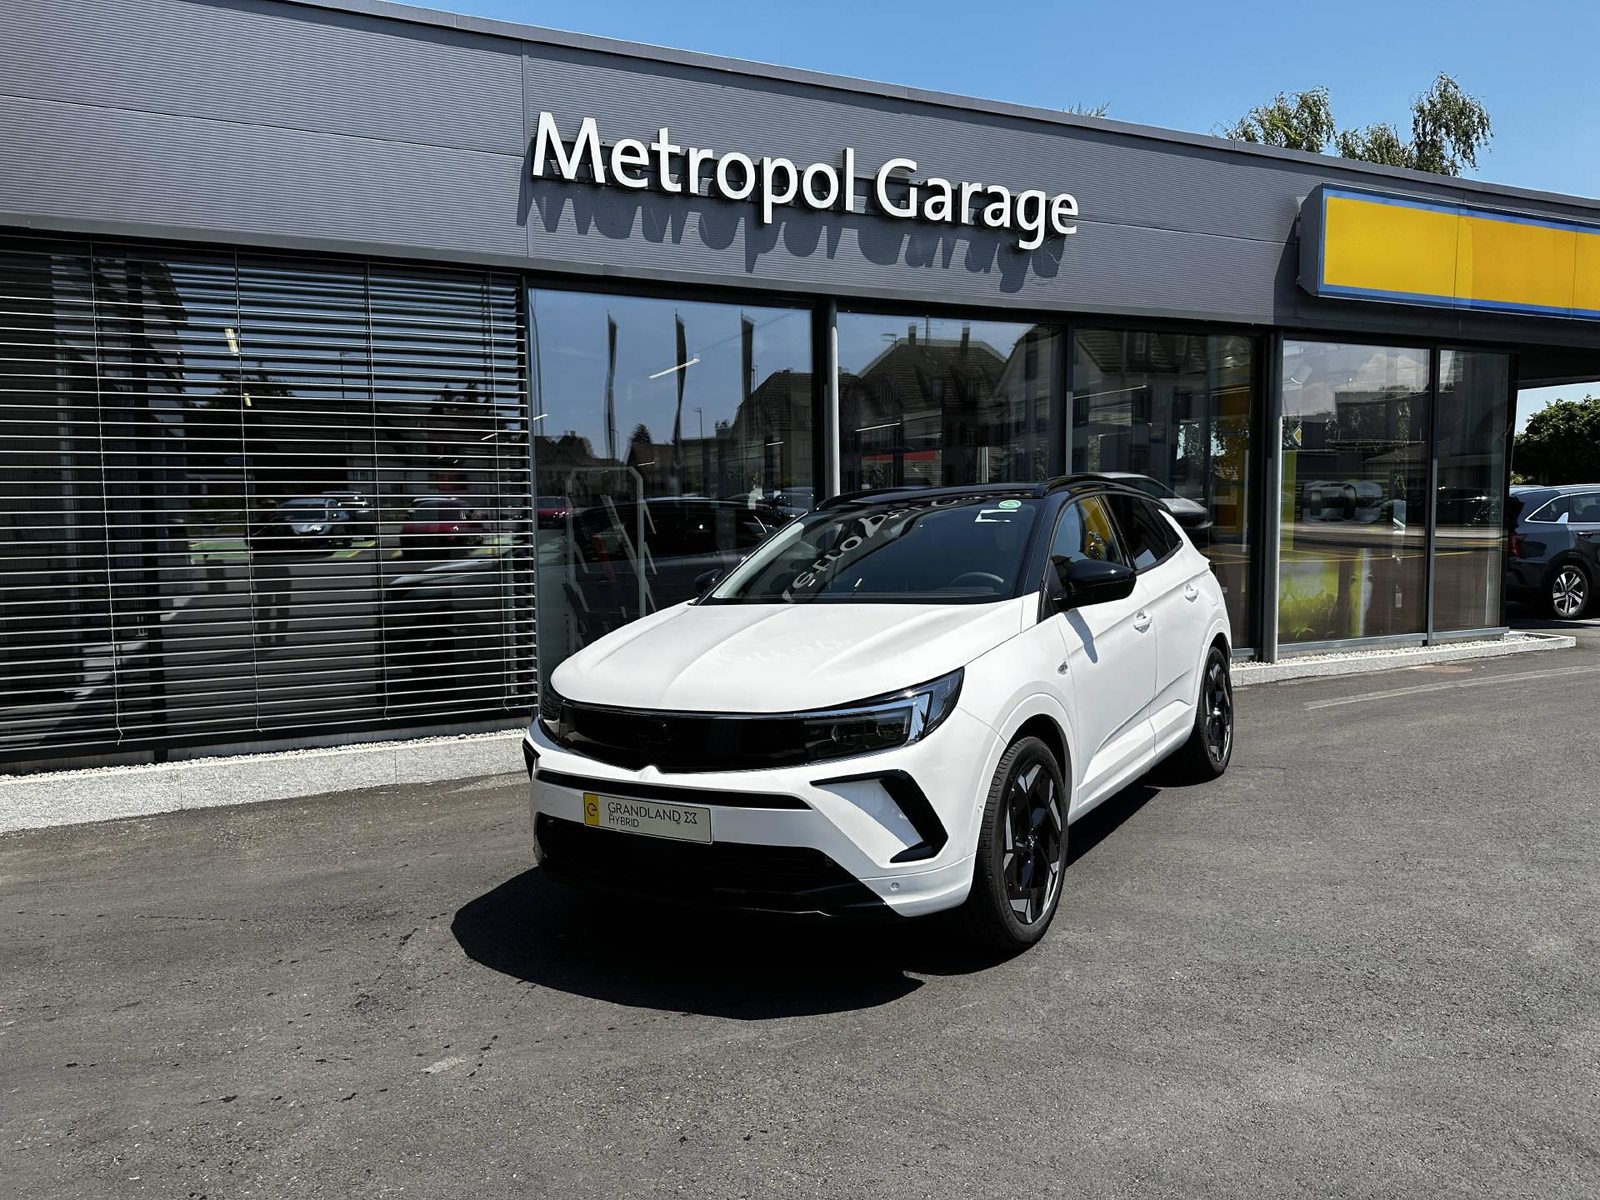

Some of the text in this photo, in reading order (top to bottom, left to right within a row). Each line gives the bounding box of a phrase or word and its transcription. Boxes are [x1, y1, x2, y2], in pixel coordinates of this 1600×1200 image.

[531, 111, 1079, 250] Metropol Garage
[607, 801, 681, 823] GRANDLAND
[608, 814, 640, 828] HYBRID
